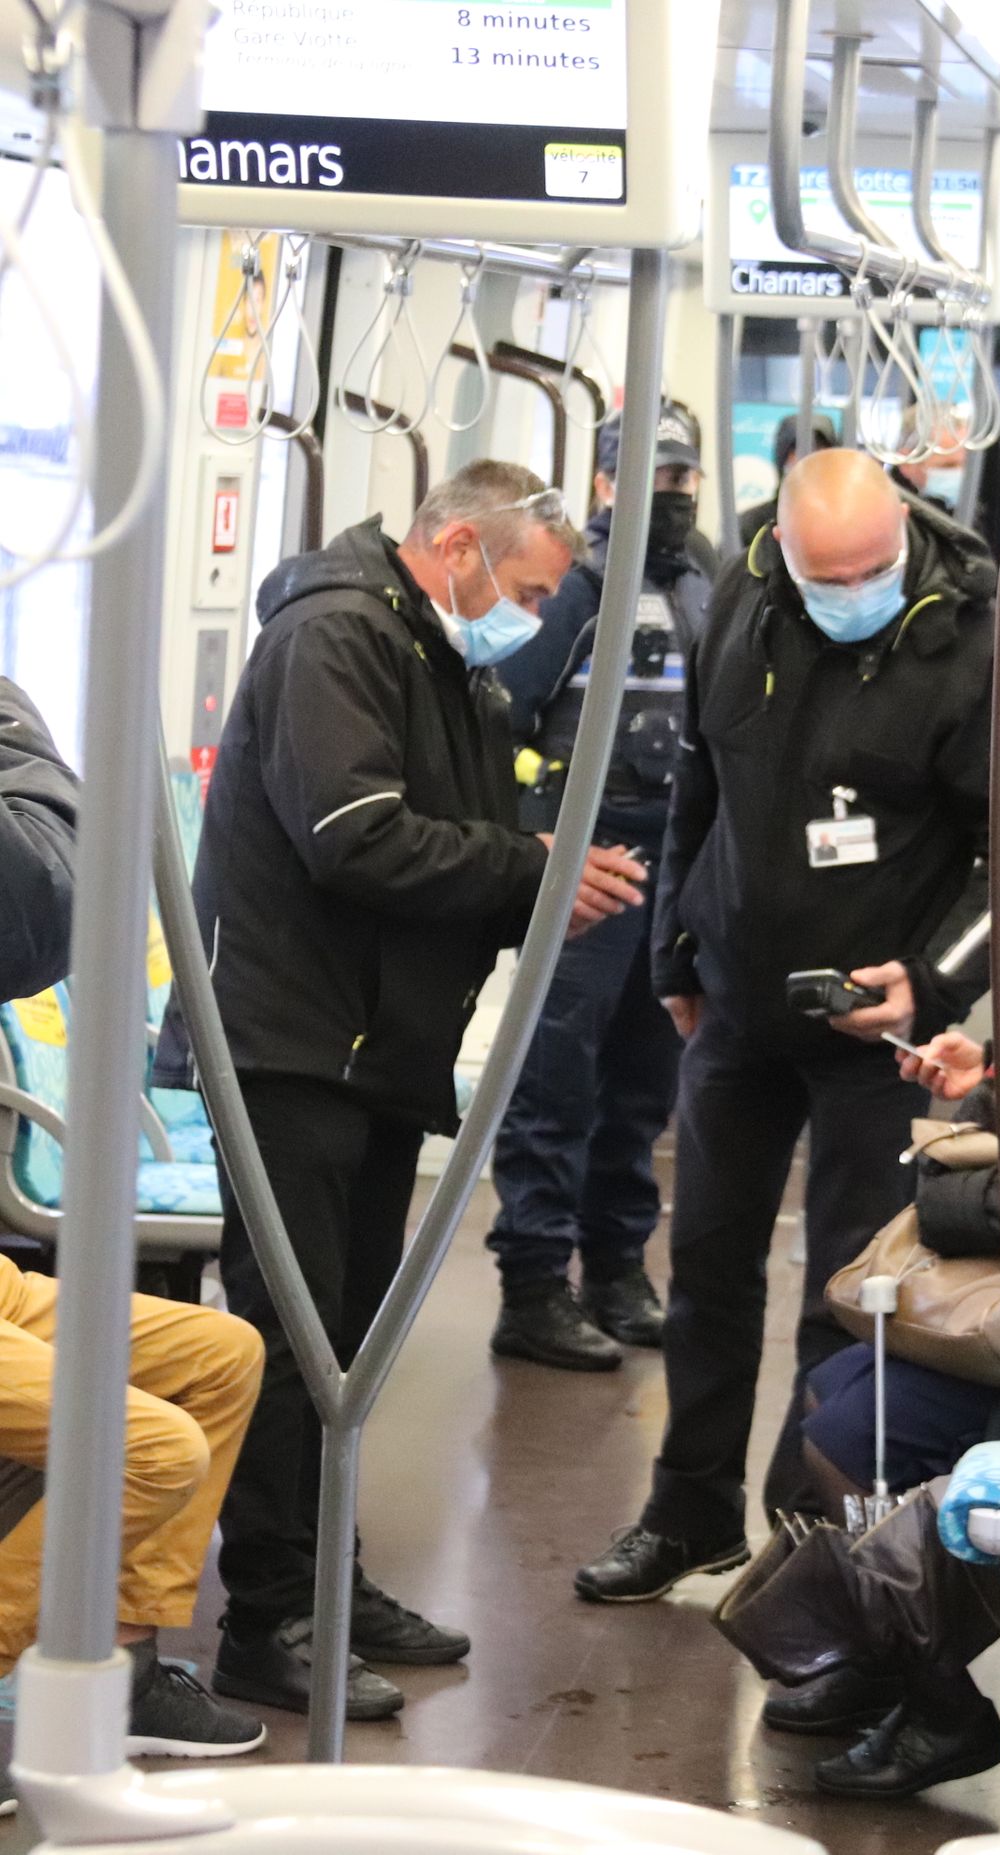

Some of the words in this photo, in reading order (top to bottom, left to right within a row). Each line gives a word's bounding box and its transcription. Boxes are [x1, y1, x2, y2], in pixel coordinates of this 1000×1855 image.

[457, 9, 472, 28] 8
[483, 11, 591, 33] minutes
[233, 27, 285, 46] Gare
[451, 47, 480, 65] 13
[492, 49, 600, 71] minutes
[177, 137, 344, 187] amars
[552, 147, 616, 164] vélocité
[578, 170, 589, 184] 7
[853, 168, 907, 192] iotte
[731, 265, 843, 297] Chamars
